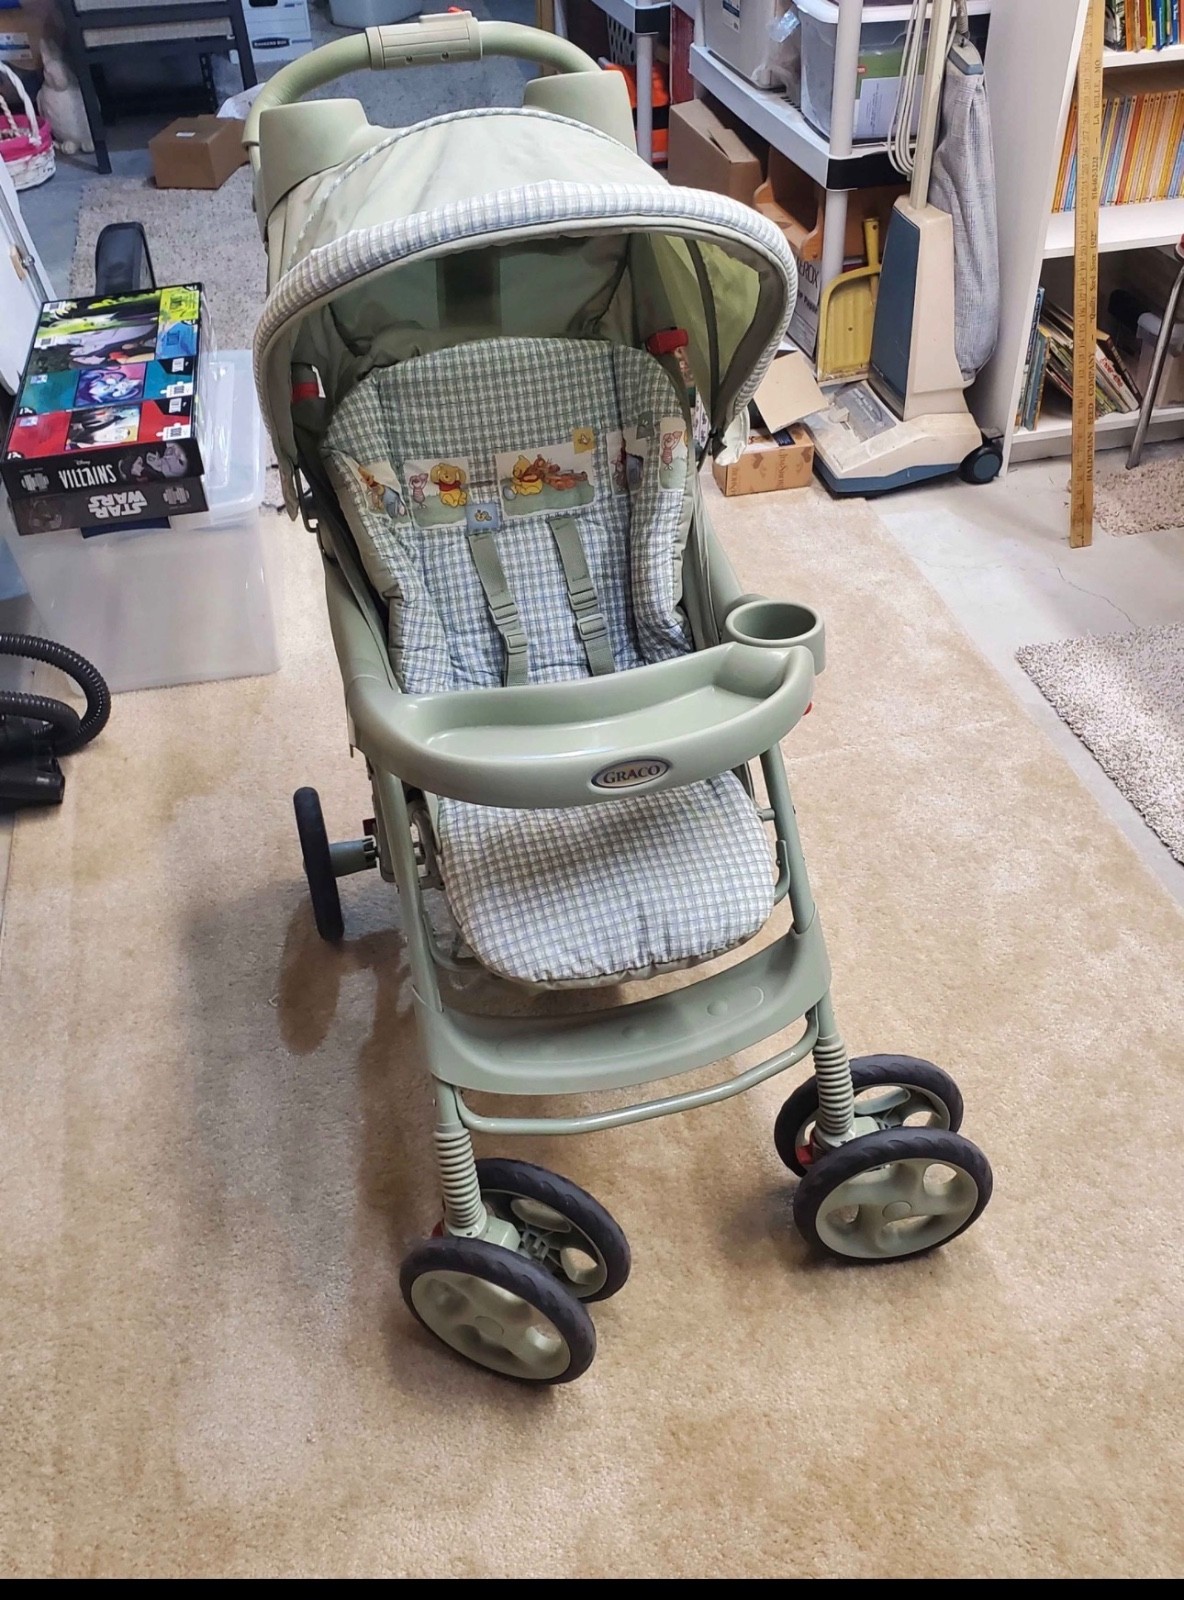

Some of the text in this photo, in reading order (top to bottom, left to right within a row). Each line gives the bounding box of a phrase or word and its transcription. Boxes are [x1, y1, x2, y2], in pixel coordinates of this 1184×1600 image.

[1087, 352, 1096, 398] COMPANY
[1087, 403, 1095, 425] SEED
[1086, 431, 1094, 482] HALDEMAN
[58, 463, 117, 490] VILLAINS
[88, 490, 148, 509] WARS
[89, 502, 148, 519] STAR
[603, 765, 660, 784] GRACO
